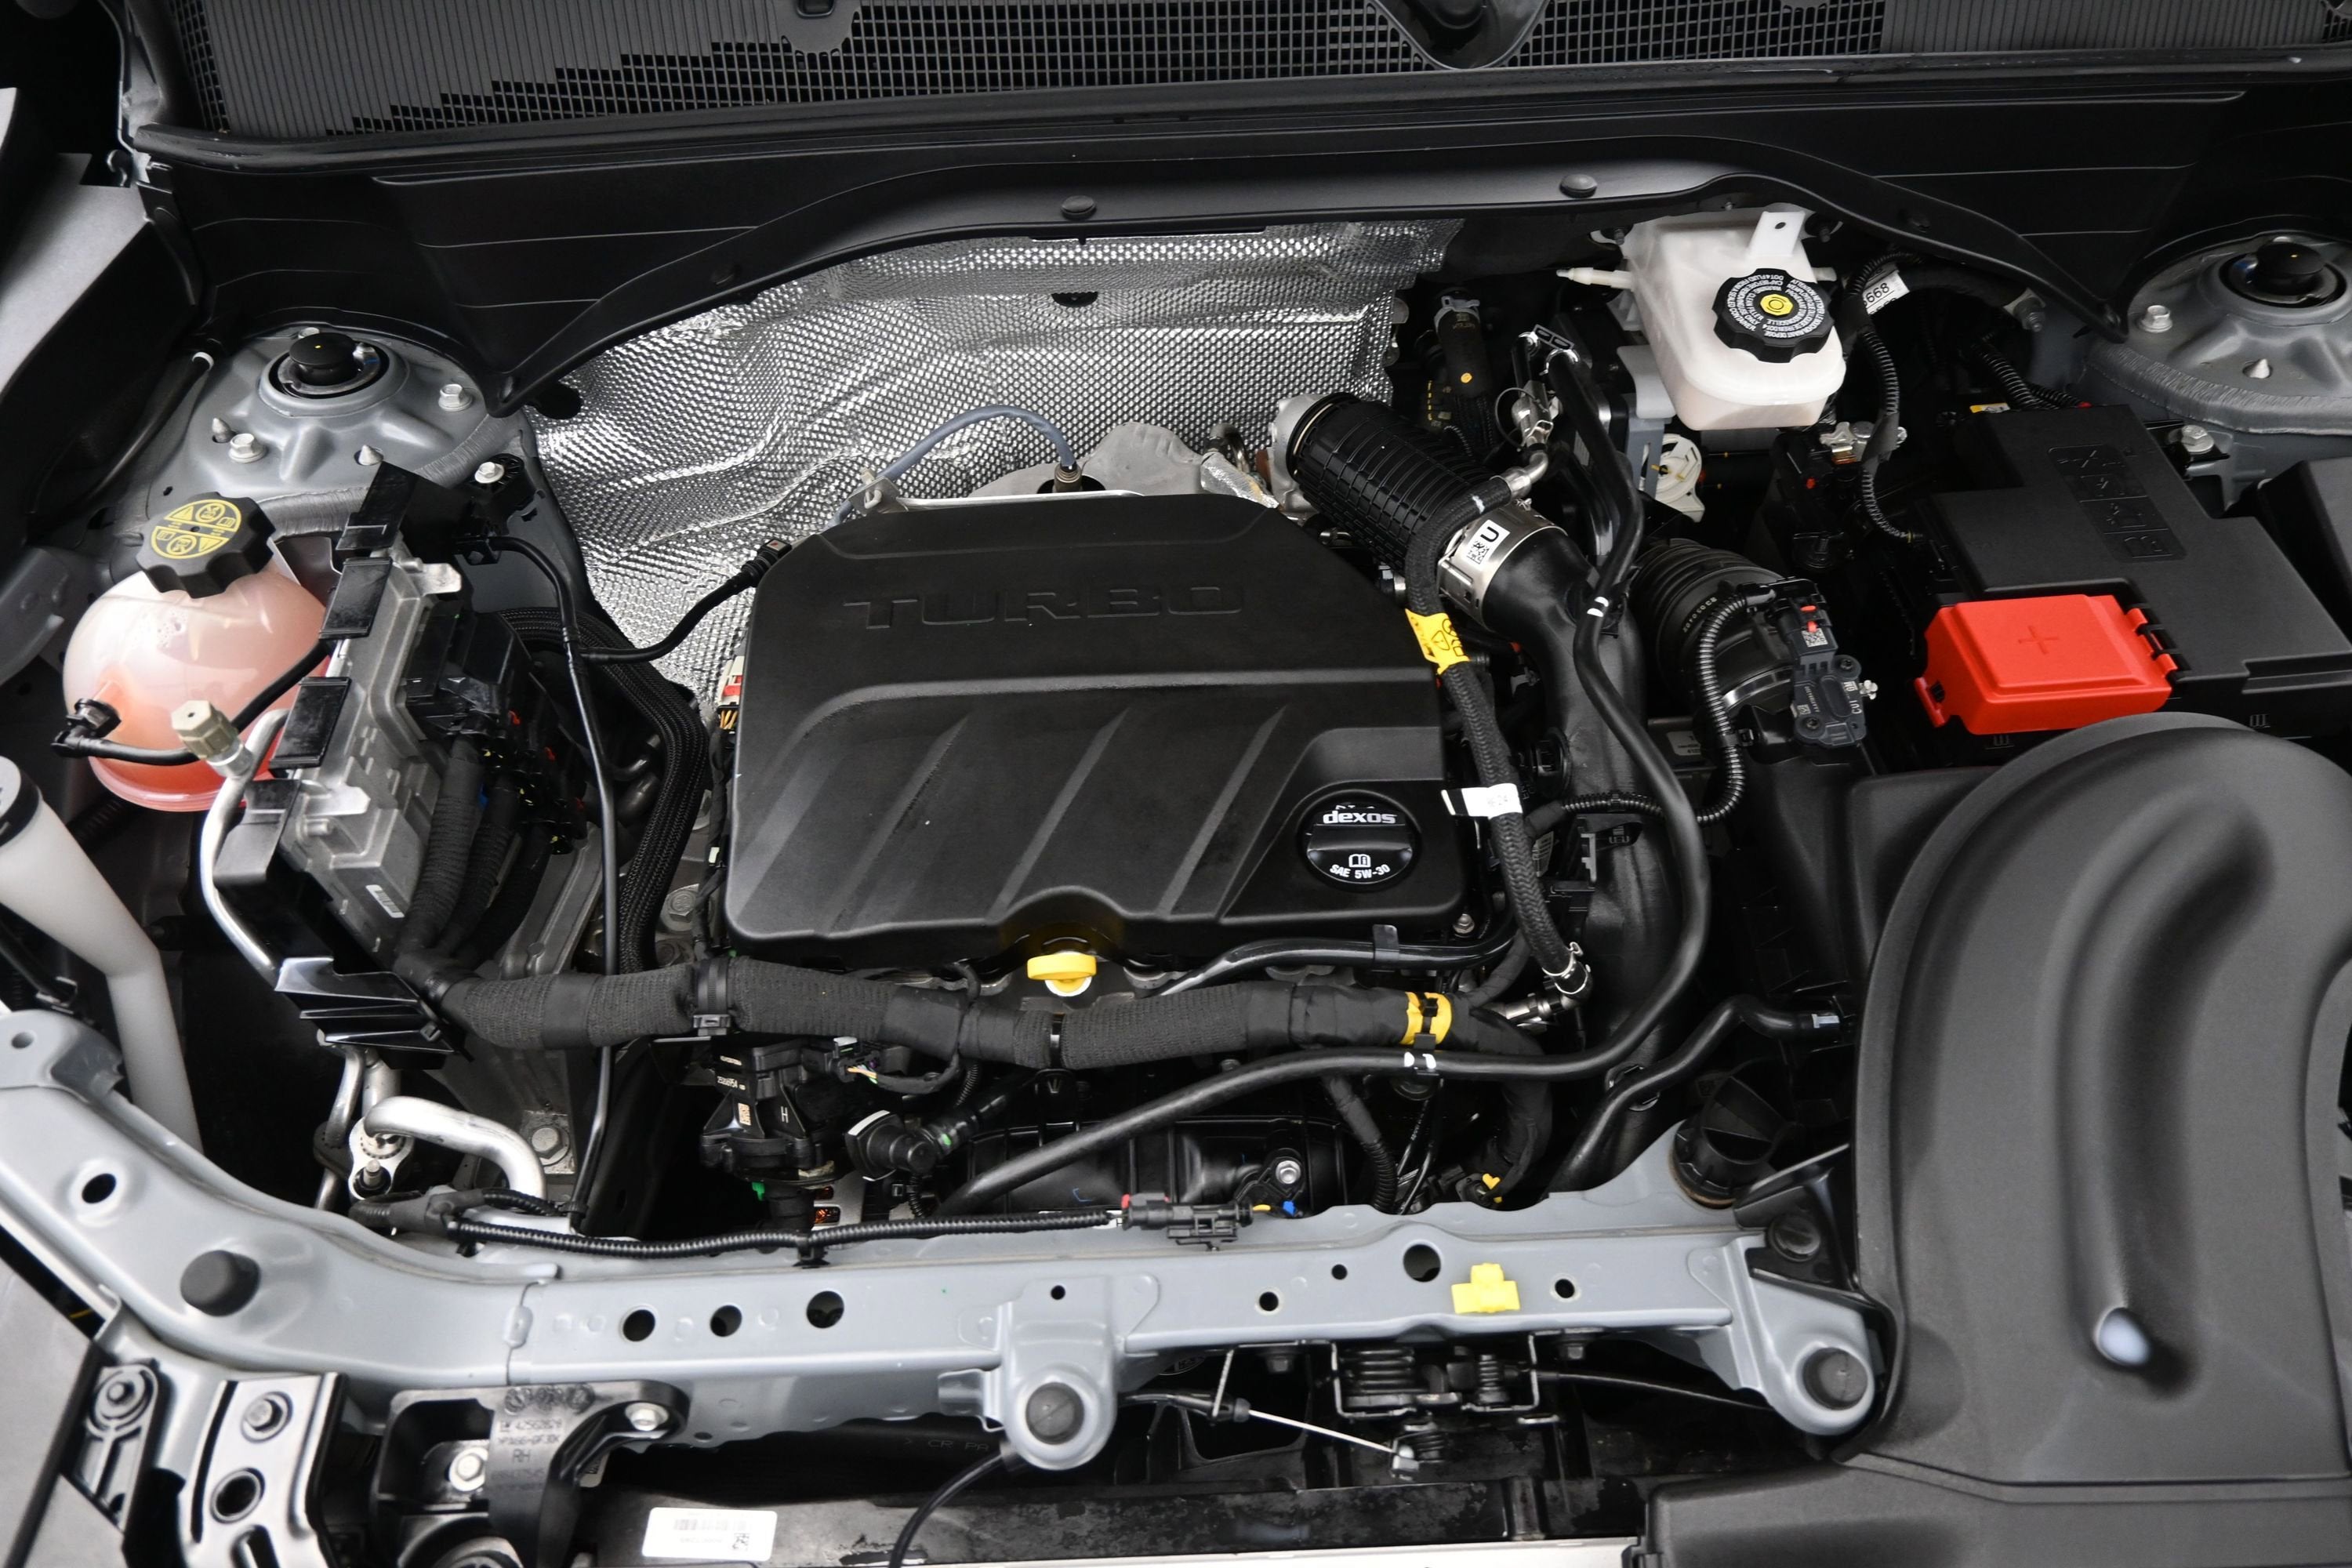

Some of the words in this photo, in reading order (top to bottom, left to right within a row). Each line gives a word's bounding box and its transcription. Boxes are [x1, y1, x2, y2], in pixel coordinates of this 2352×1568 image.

[1727, 292, 1737, 307] SEALED
[1746, 293, 1756, 306] CLEAN
[1744, 314, 1760, 326] ONLY
[1748, 307, 1764, 321] FILLER
[1480, 526, 1499, 543] U
[843, 586, 1243, 630] TURBO
[1323, 811, 1397, 824] dexos
[1330, 864, 1351, 878] SAE
[1355, 864, 1391, 879] 5W-30
[513, 1448, 531, 1464] RH
